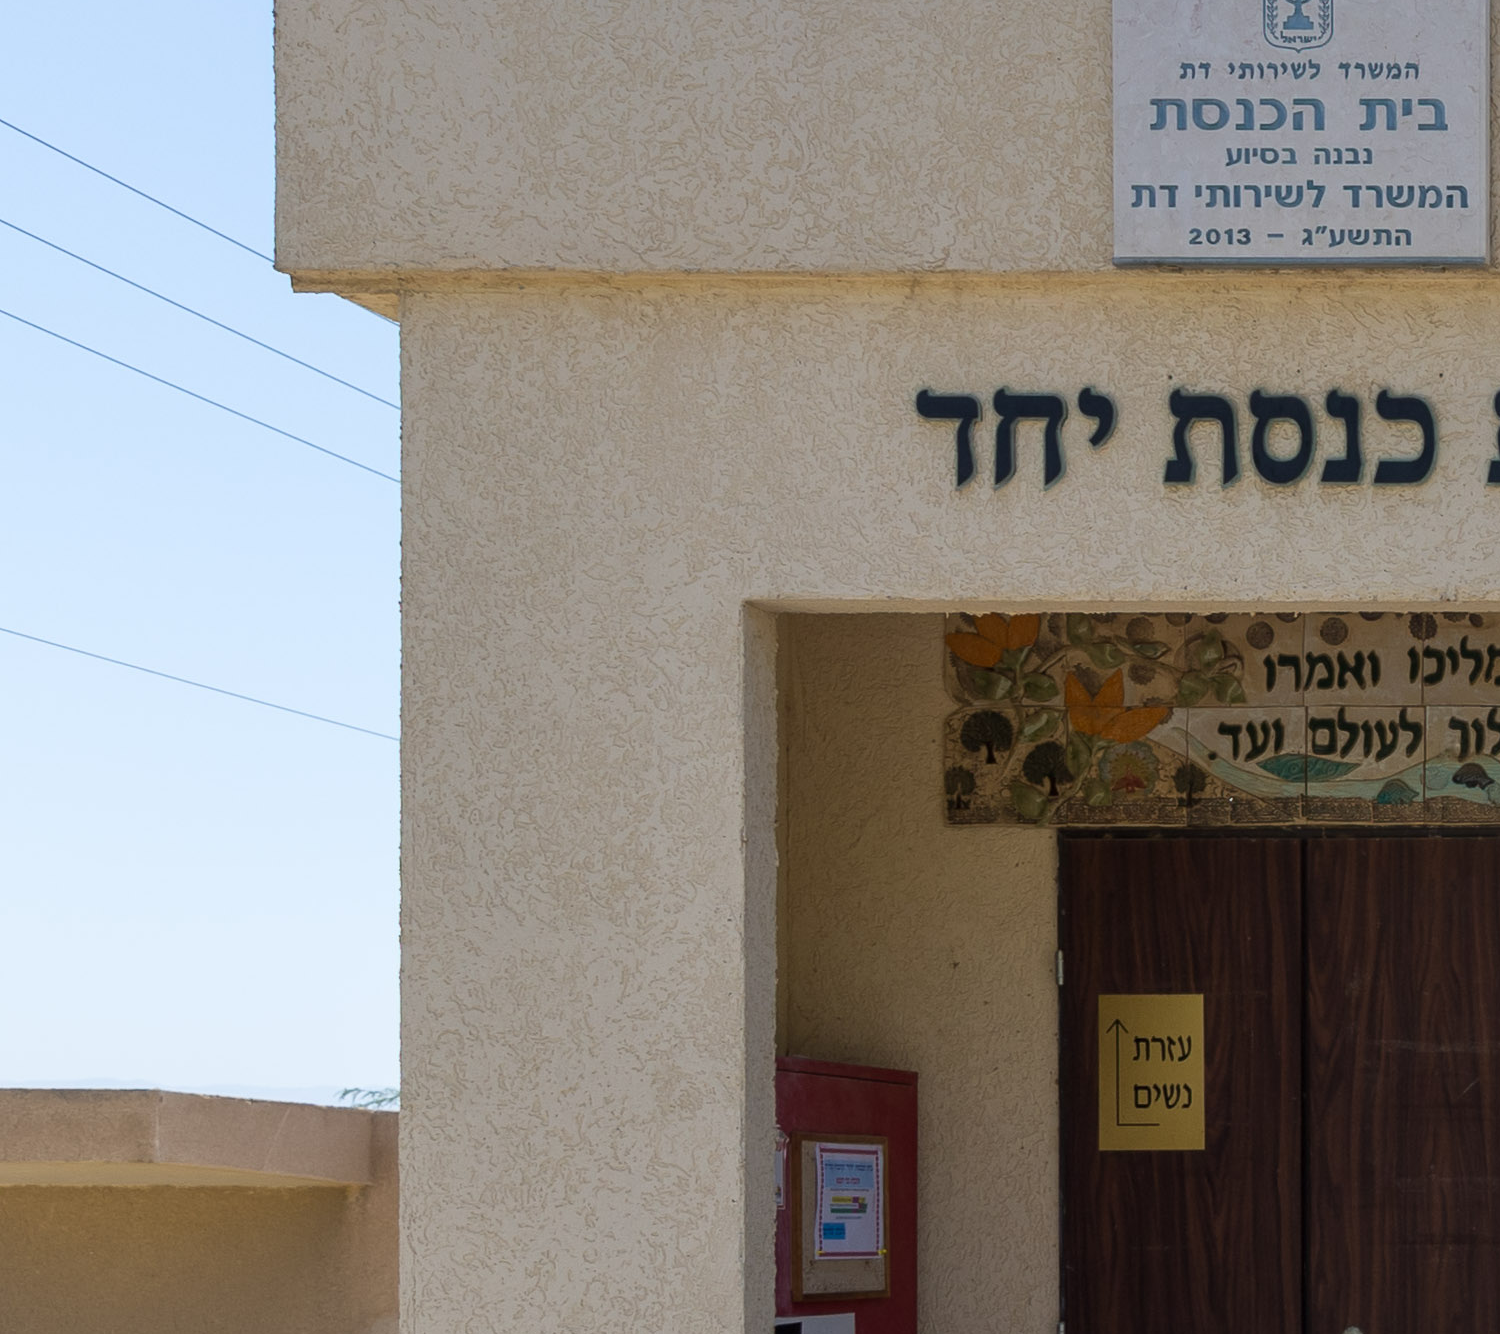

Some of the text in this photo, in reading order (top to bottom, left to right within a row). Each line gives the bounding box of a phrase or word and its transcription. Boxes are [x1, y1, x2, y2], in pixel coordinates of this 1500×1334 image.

[1280, 30, 1318, 43] ישראל
[1179, 58, 1420, 81] המשרד לשירותי דת
[1149, 97, 1449, 132] בית הכנסת
[1225, 147, 1374, 167] נבנה בסיוע
[1130, 179, 1469, 209] המשרד לשירותי דת
[1188, 228, 1252, 246] 2013
[915, 386, 1118, 490] יחד
[1161, 386, 1440, 490] כנסת
[1263, 650, 1381, 693] ואמרו
[1307, 706, 1424, 762] לעולם
[1132, 1035, 1193, 1063] עזרת
[1133, 1082, 1193, 1110] נשים
